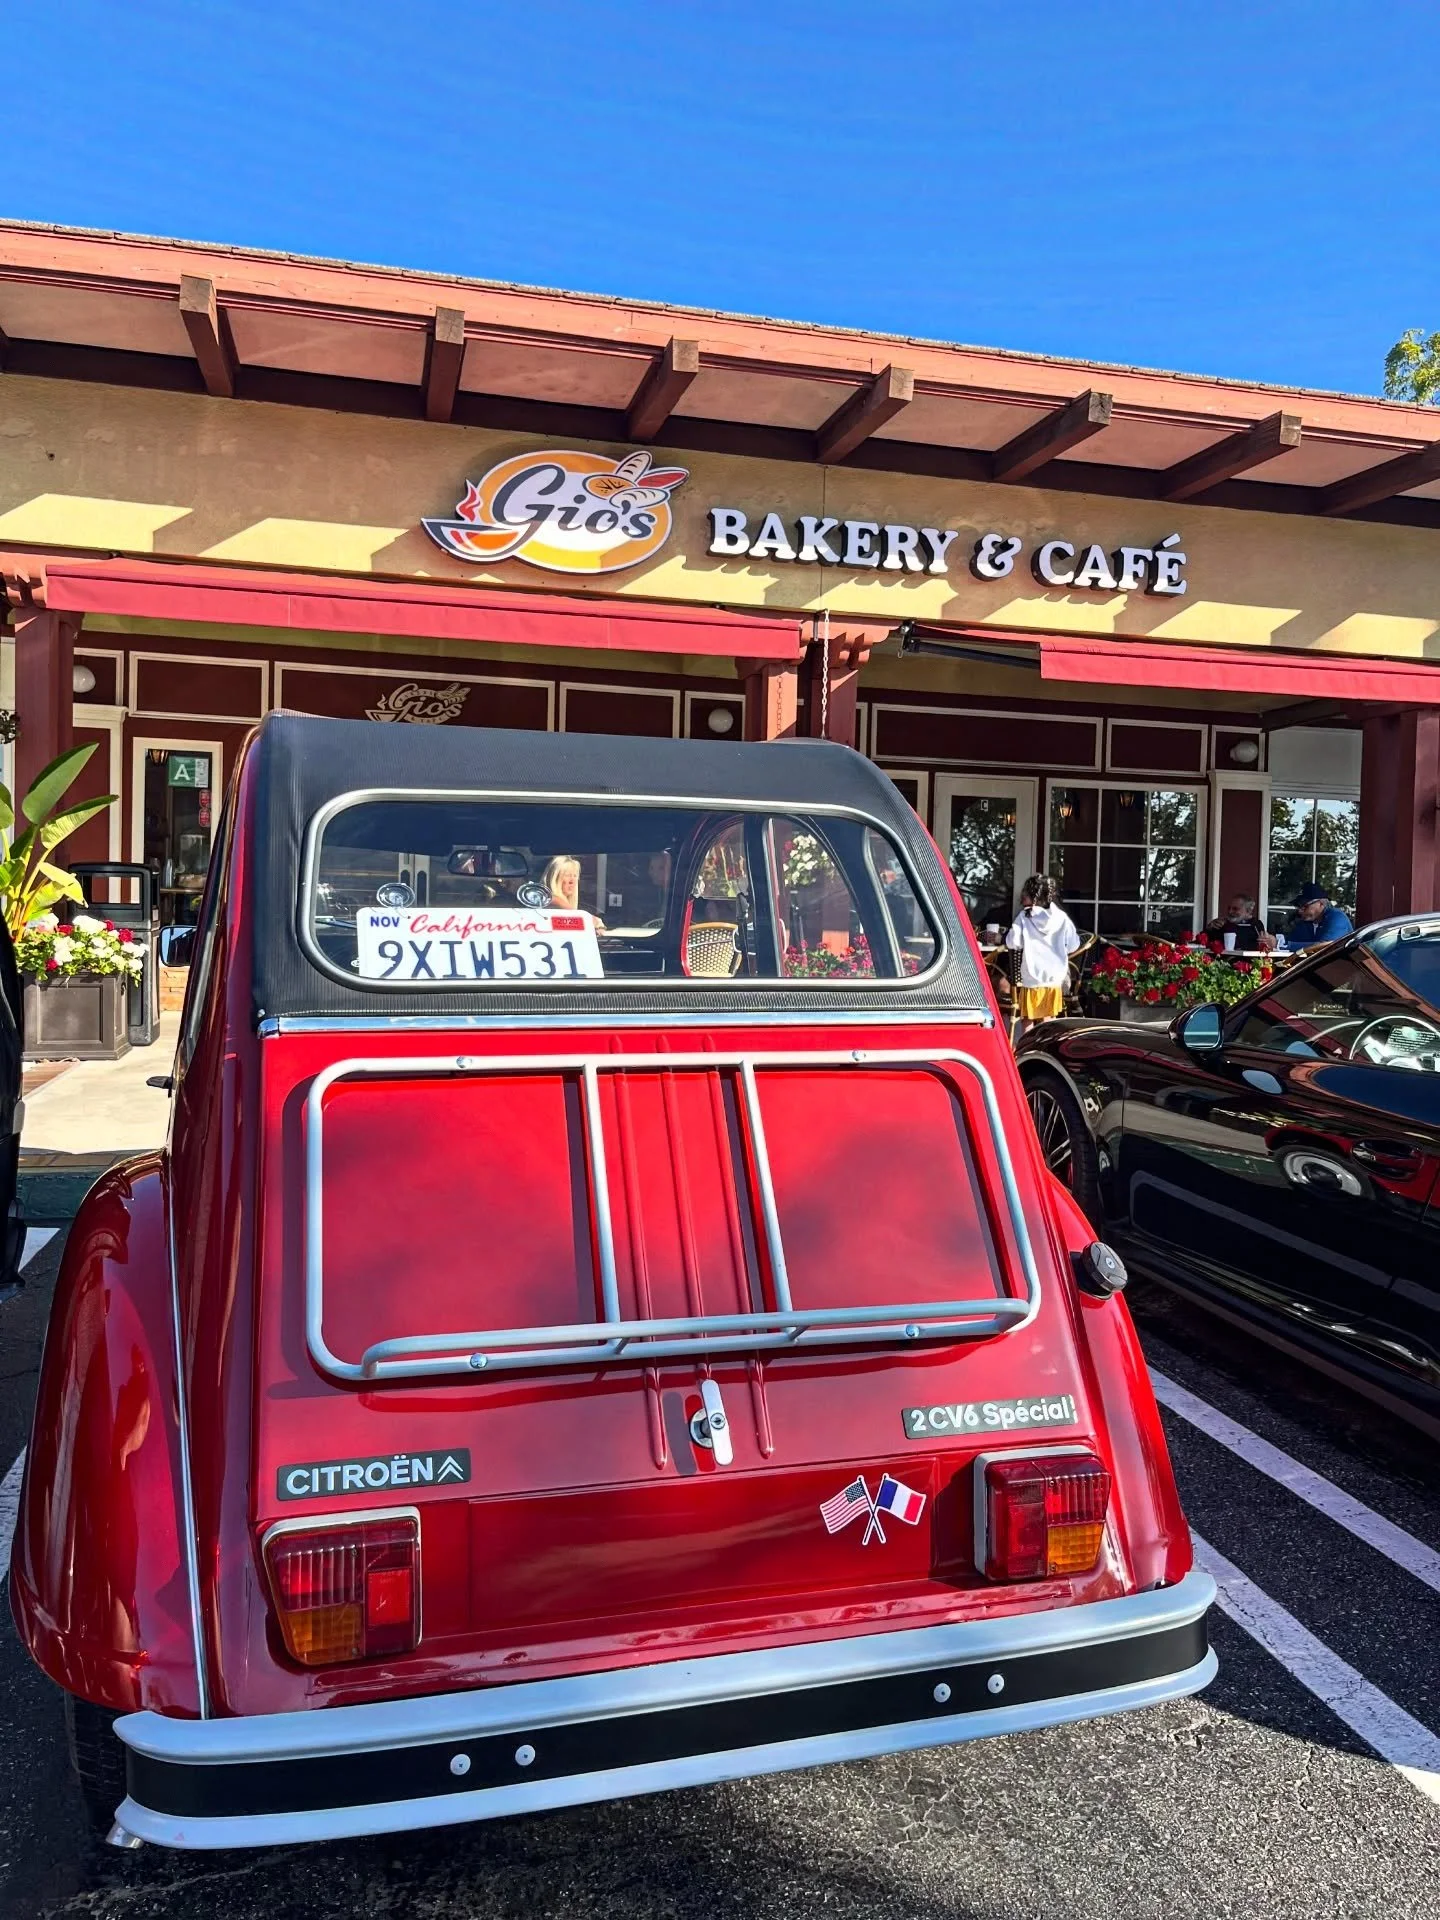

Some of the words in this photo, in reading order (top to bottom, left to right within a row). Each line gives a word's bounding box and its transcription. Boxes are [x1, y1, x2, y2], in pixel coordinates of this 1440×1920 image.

[490, 463, 656, 550] Gio's
[708, 507, 959, 574] BAKERY
[972, 532, 1022, 579] &
[1034, 532, 1188, 596] CAFÉ
[387, 682, 463, 722] Gio's
[173, 763, 191, 781] A
[369, 916, 400, 928] NOV
[409, 913, 553, 939] California
[377, 939, 588, 979] 9XIW531
[982, 1396, 1071, 1430] Spécial
[285, 1455, 434, 1495] CITROËN
